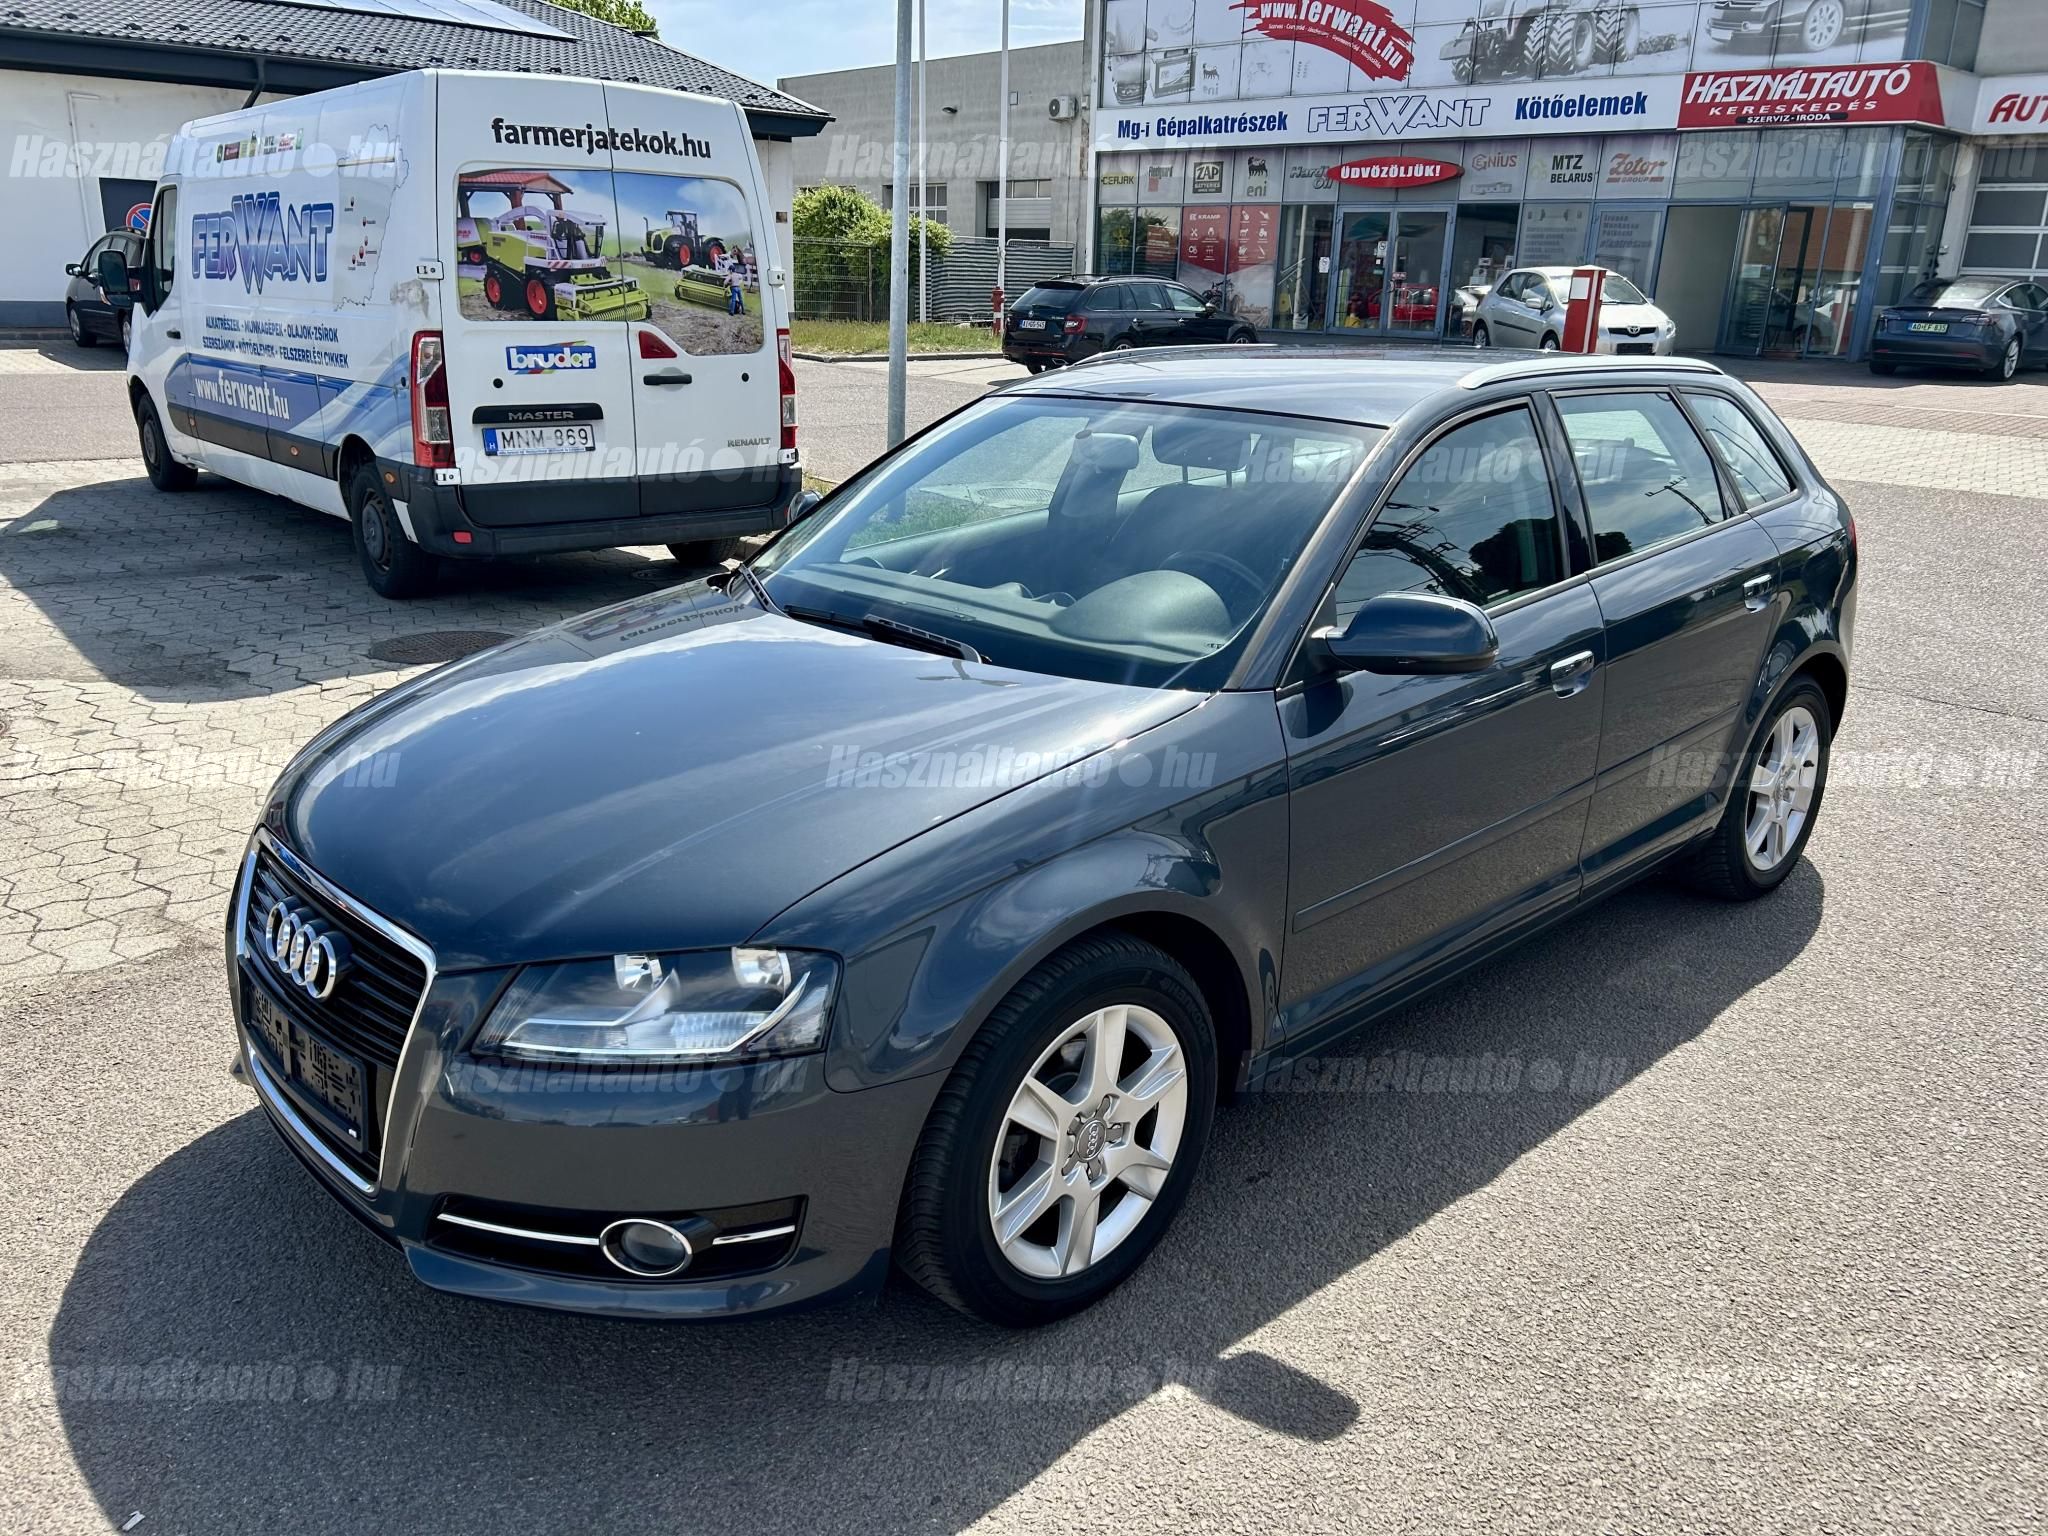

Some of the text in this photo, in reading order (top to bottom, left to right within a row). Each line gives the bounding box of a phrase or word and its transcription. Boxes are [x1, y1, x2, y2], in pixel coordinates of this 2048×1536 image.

[1685, 64, 1912, 104] HASZNÁLTAUTÓ
[1515, 91, 1648, 120] Kötőelemek
[1709, 99, 1878, 116] KERESKEDÉS
[1117, 111, 1289, 140] Mg-i Gépalkatrészek
[491, 117, 712, 159] farmerjatekok.hu
[1552, 155, 1583, 171] MTZ
[1609, 152, 1669, 176] Zetor
[1195, 166, 1220, 180] ZAP
[1340, 165, 1441, 179] ÜDVÖZÖLJÜK!
[1550, 172, 1593, 184] BELARUS
[1246, 181, 1267, 197] eni
[323, 352, 349, 368] CIKKEK
[509, 347, 592, 369] bruder
[194, 369, 290, 420] www.ferwant.hu
[508, 411, 575, 421] MASTER
[501, 428, 589, 449] MNM-869
[727, 437, 771, 447] RENAULT
